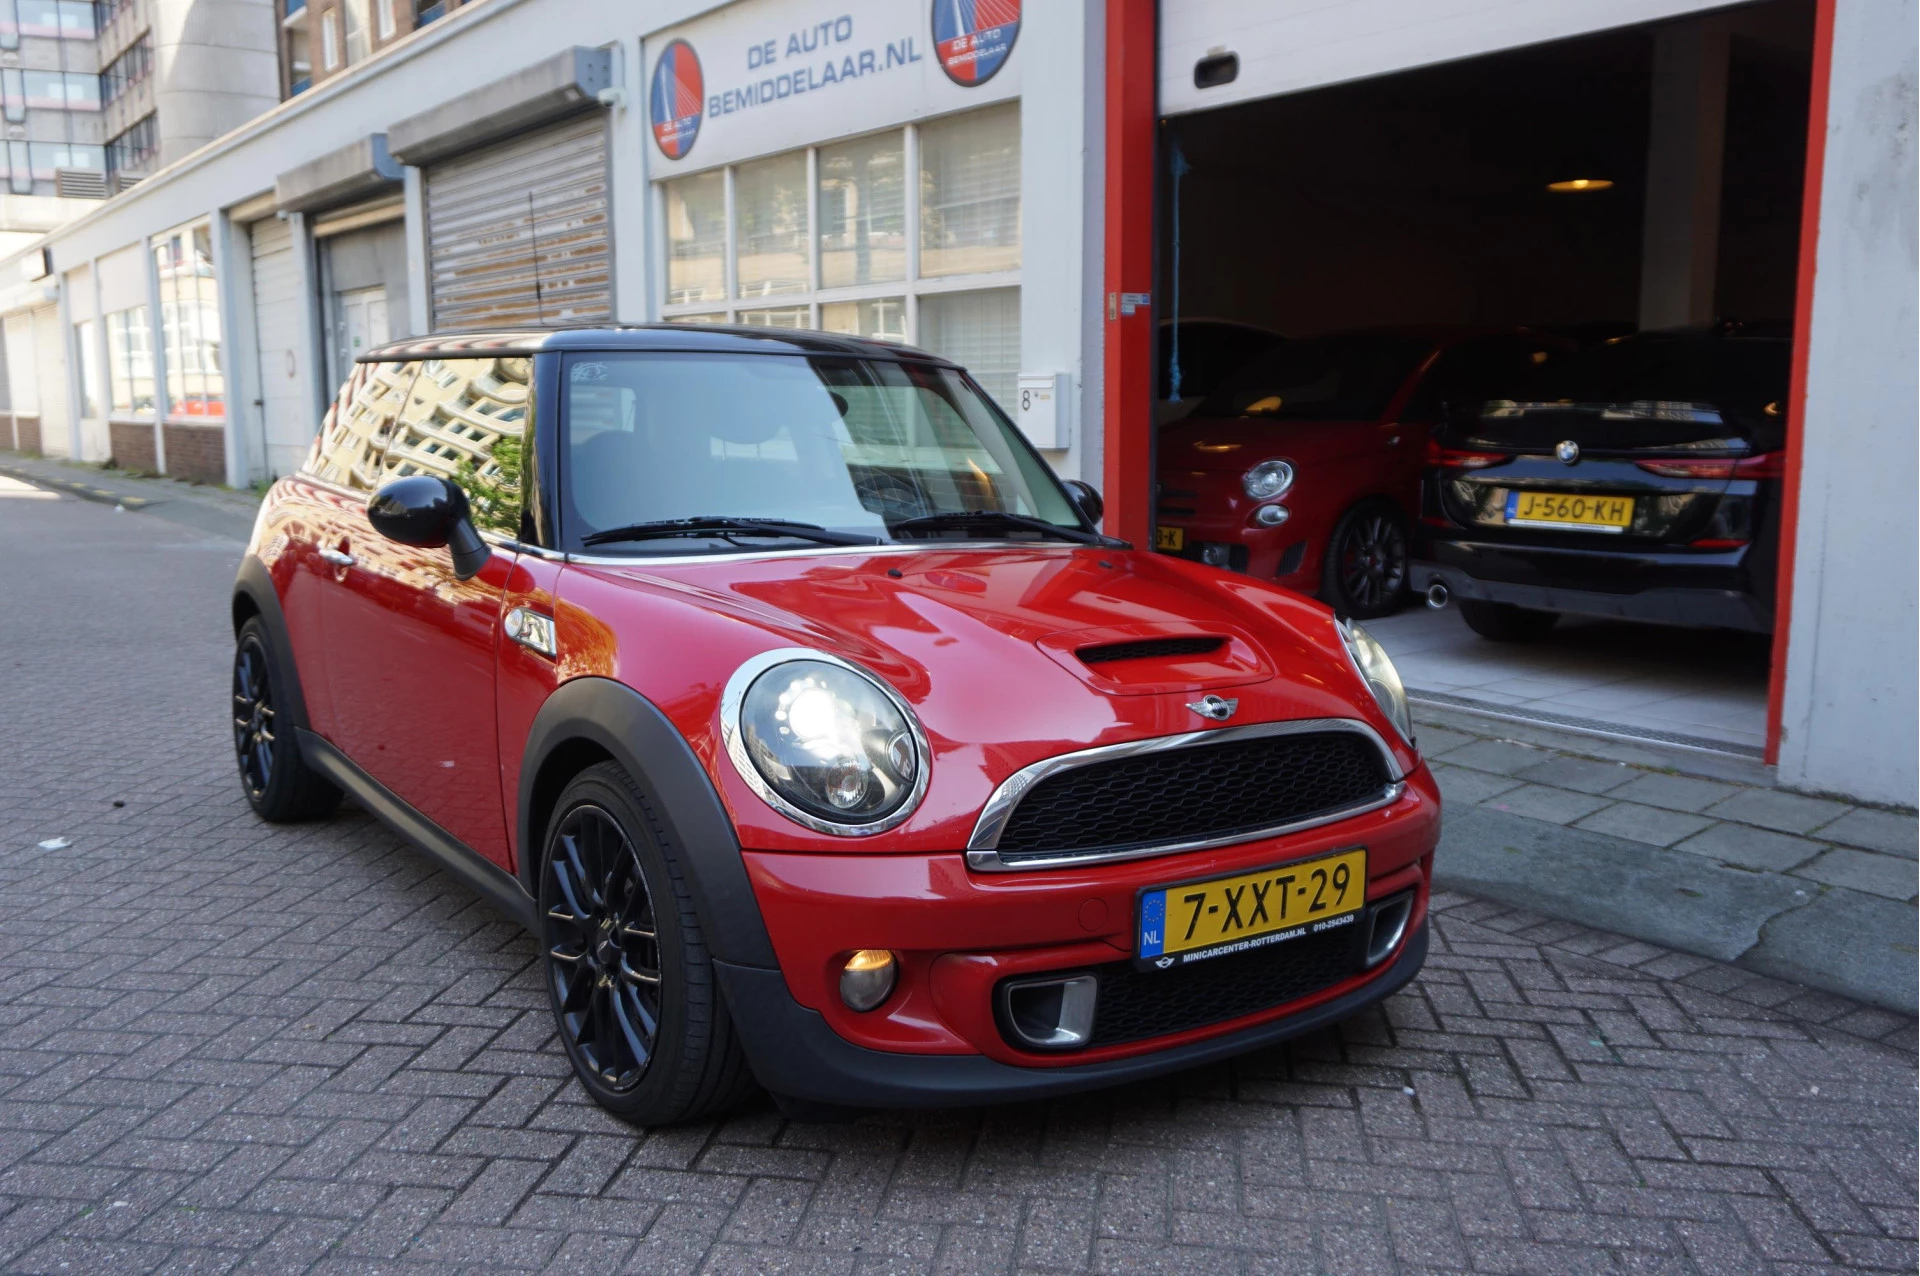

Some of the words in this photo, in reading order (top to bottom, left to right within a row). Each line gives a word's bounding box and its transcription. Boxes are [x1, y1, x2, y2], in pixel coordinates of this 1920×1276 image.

[747, 38, 777, 70] DE
[784, 14, 853, 58] AUTO
[952, 37, 968, 51] DE
[970, 28, 1002, 47] AUTO
[708, 36, 922, 118] BEMIDDELAAR.NL
[1022, 389, 1031, 411] 8
[1523, 496, 1626, 521] J-560-KH
[1183, 863, 1350, 940] 7-XXT-29
[1143, 930, 1161, 945] NL
[1183, 928, 1306, 962] MINICARCENTER-ROTTERDAM.NL
